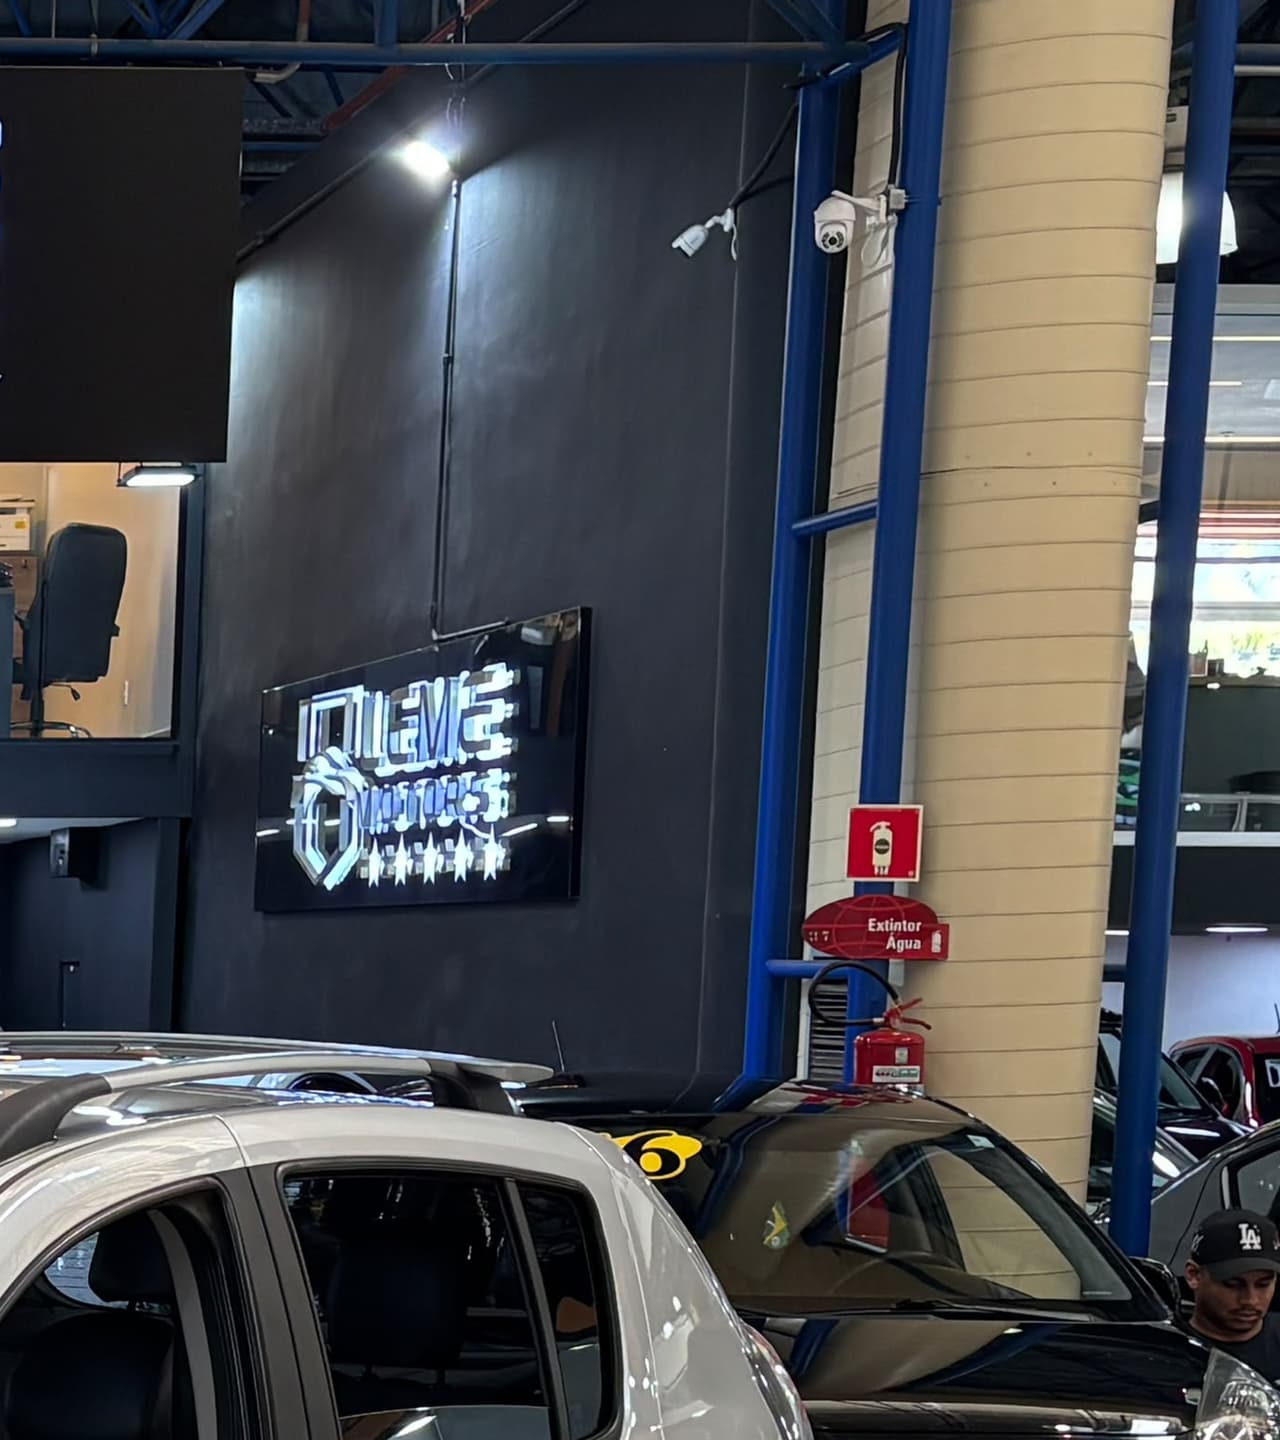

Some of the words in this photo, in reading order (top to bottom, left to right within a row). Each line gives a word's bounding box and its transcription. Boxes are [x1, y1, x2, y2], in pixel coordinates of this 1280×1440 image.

[868, 918, 922, 933] Extintor
[886, 934, 922, 952] Água
[1238, 1222, 1263, 1251] LA
